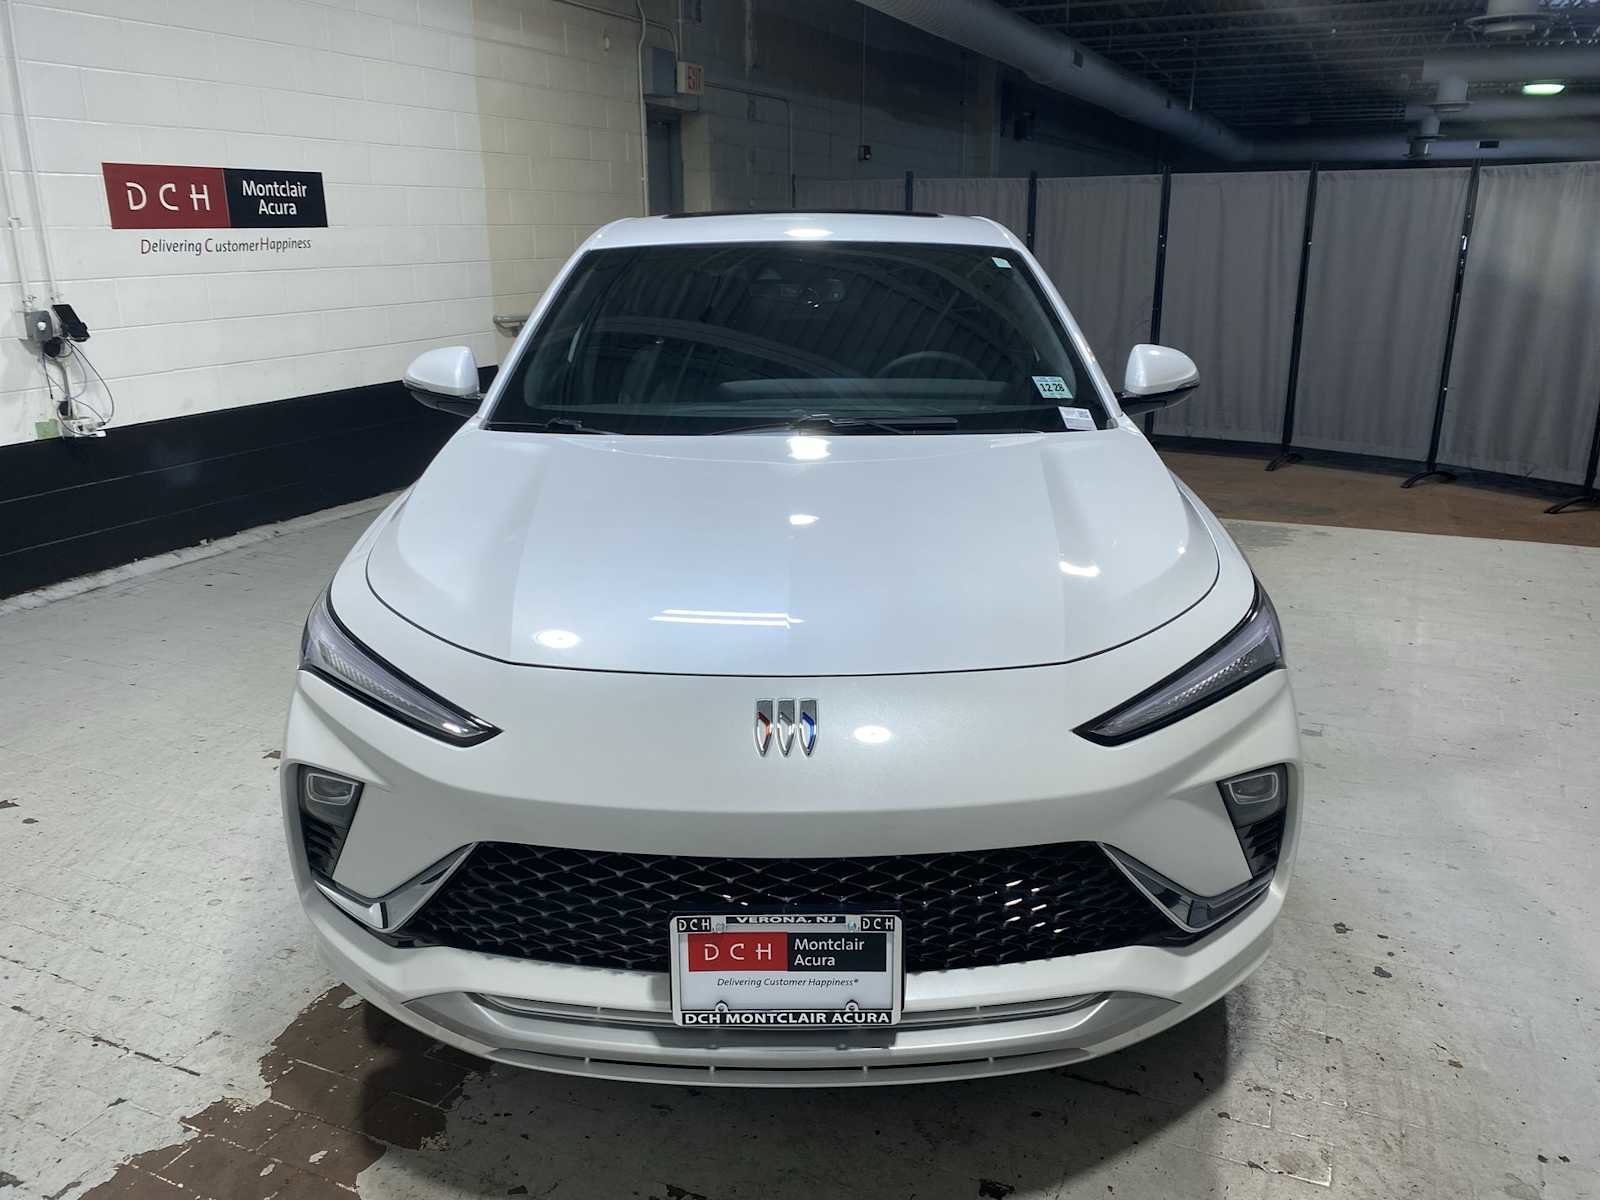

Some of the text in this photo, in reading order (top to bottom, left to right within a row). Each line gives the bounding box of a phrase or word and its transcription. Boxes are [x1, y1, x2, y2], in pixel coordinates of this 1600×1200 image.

[242, 179, 307, 198] Montclair
[125, 182, 211, 211] DCH
[258, 199, 297, 216] Acura
[141, 237, 312, 256] Delivering Customer Happiness
[678, 919, 711, 931] DCH
[816, 916, 837, 924] NJ
[862, 918, 894, 930] DCH
[794, 938, 865, 951] Montclair
[704, 943, 772, 961] DCH
[794, 954, 836, 967] Acura
[717, 977, 762, 988] Delivering
[764, 978, 807, 987] Customer
[684, 1012, 890, 1024] DCH MONTCLAIR ACURA
